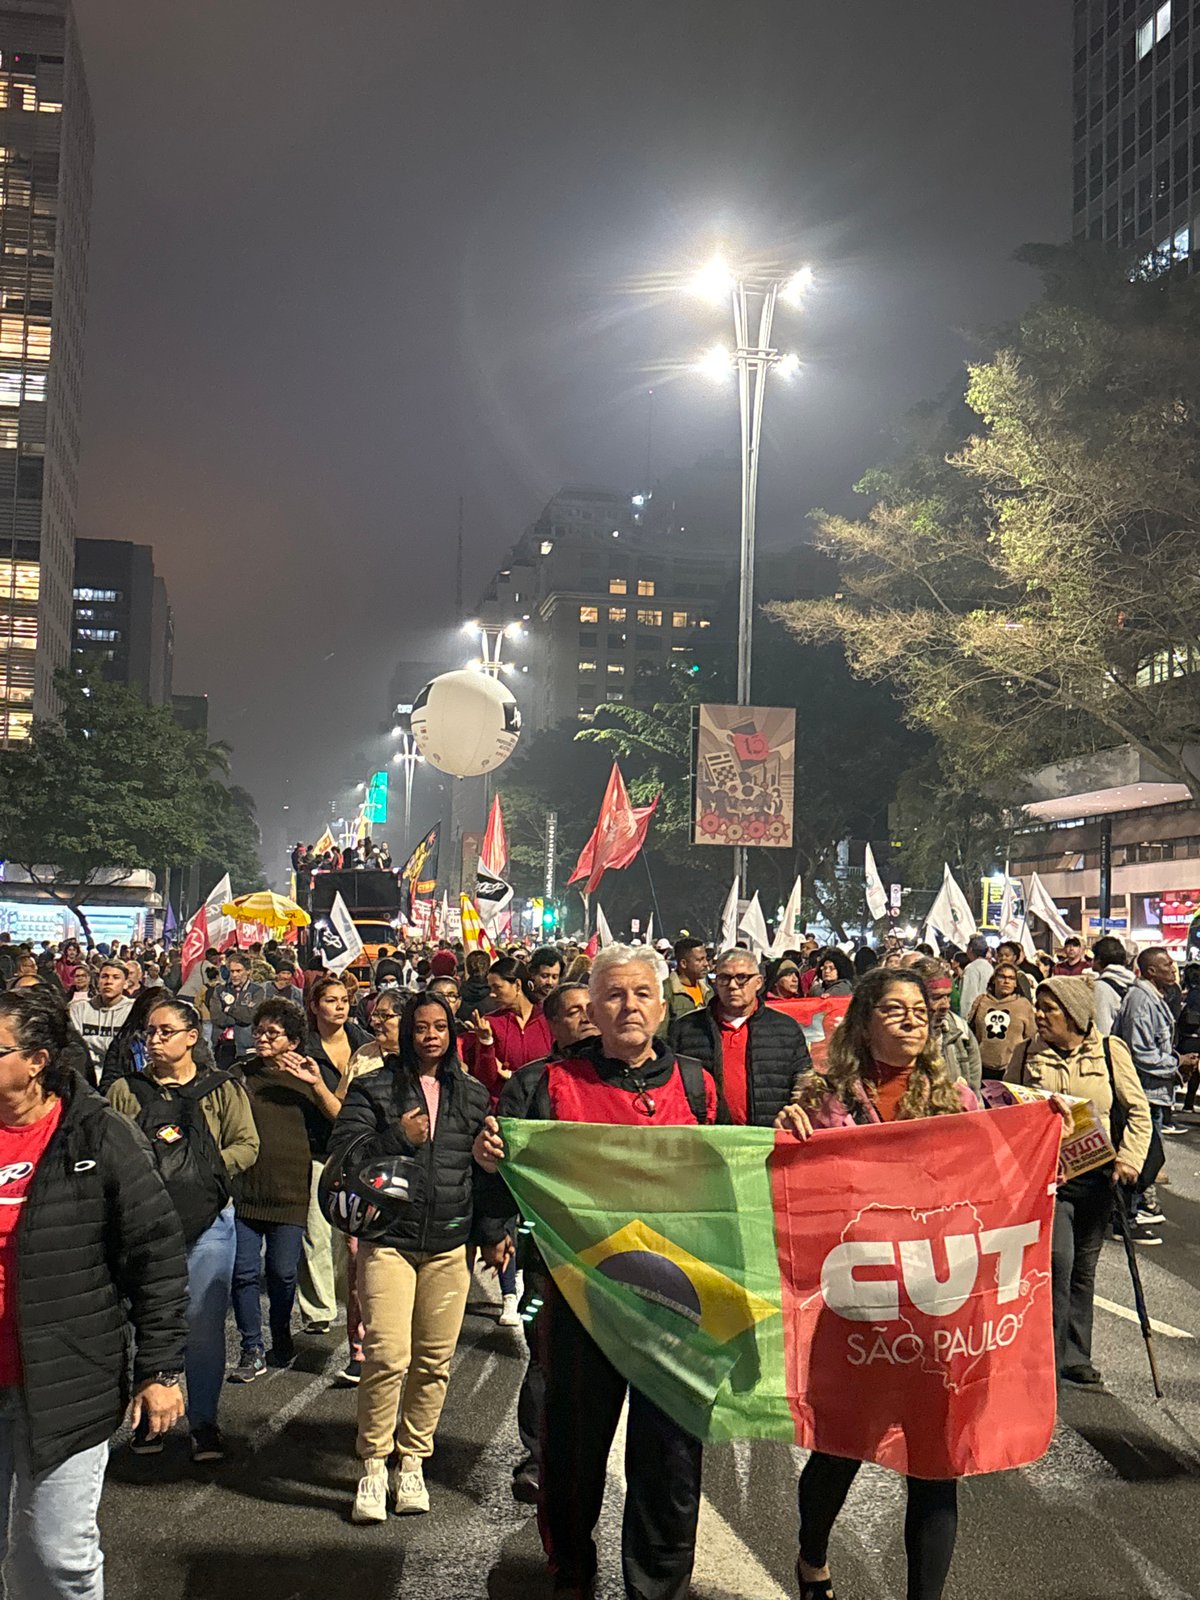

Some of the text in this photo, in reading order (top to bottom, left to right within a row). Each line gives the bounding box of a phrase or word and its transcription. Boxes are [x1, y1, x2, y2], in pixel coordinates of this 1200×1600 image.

[820, 1220, 1041, 1321] CUT
[847, 1313, 1019, 1366] SÃO PAULO
